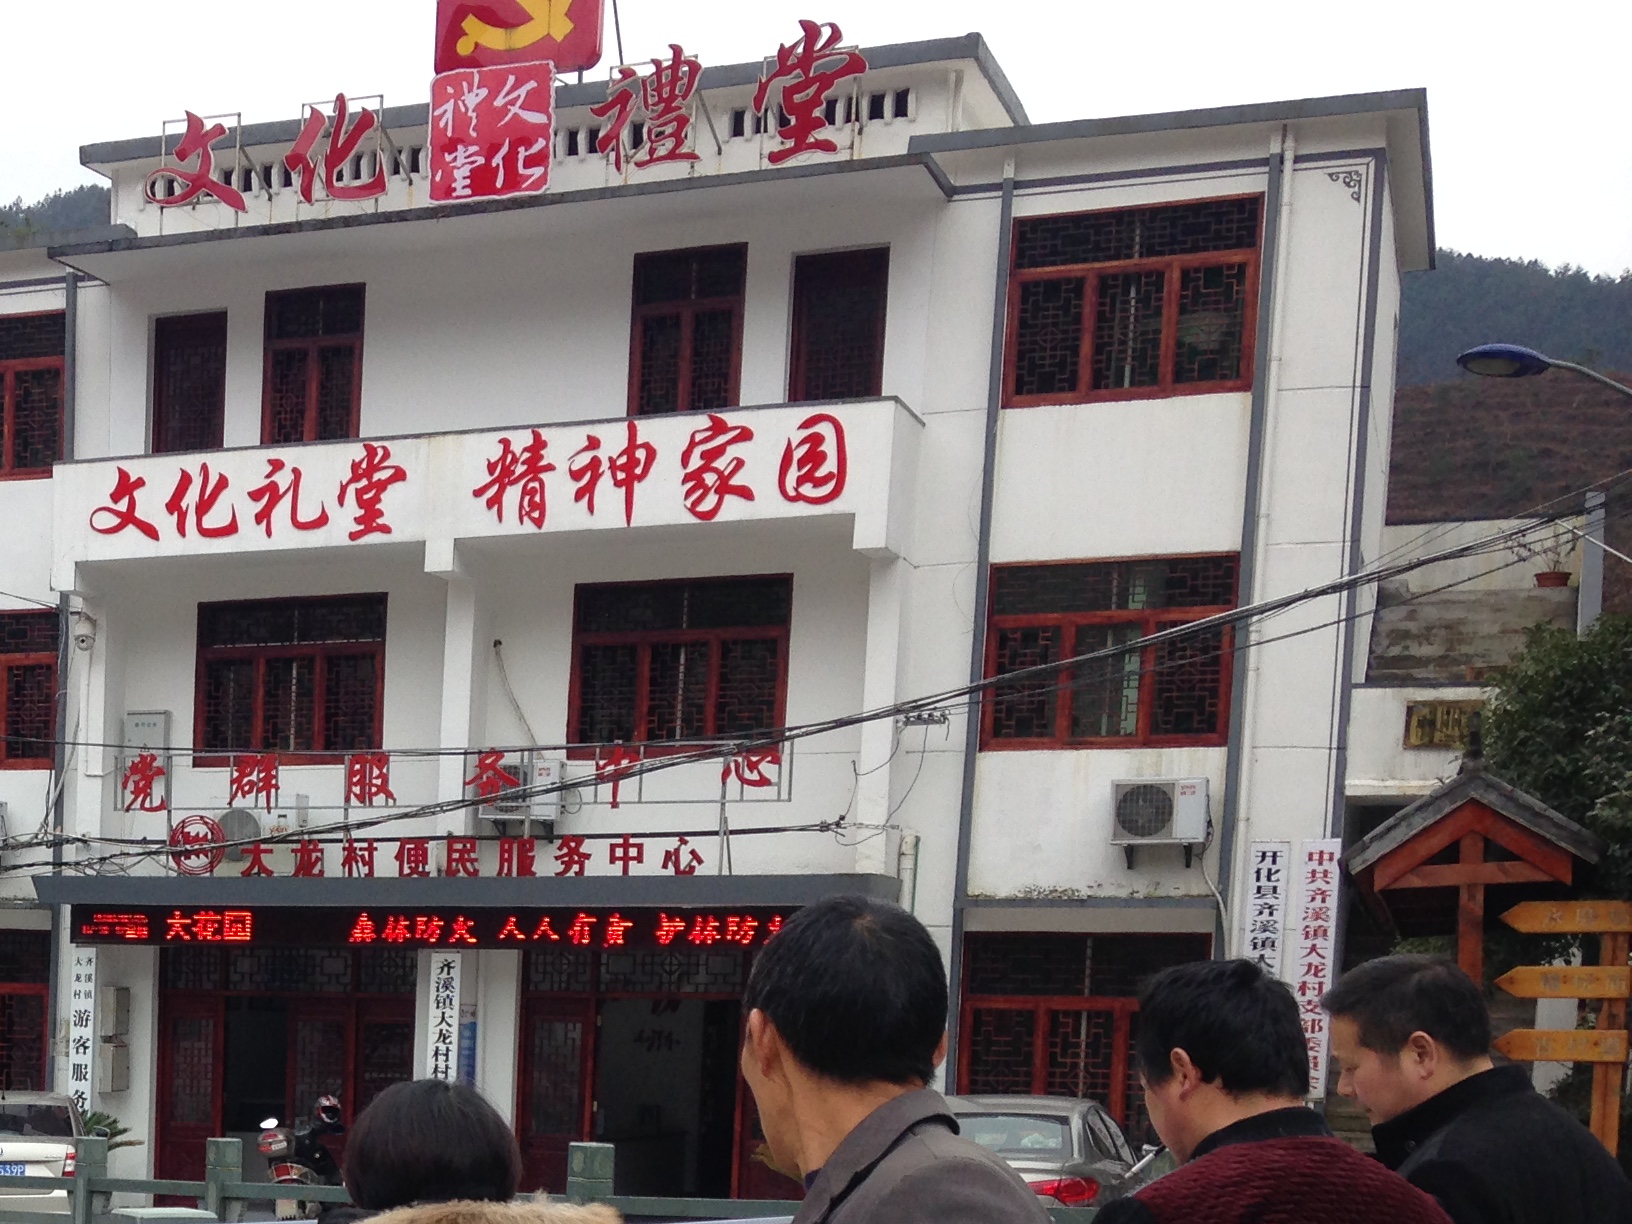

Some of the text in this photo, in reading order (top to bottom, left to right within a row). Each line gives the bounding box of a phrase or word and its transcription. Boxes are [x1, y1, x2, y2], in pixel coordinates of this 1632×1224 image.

[145, 92, 388, 213] 文化
[89, 412, 848, 542] 文化礼堂 精神家园
[121, 747, 781, 814] 党群服务中心
[240, 834, 705, 877] 大龙村便民服务中心
[166, 910, 253, 941] 大花园
